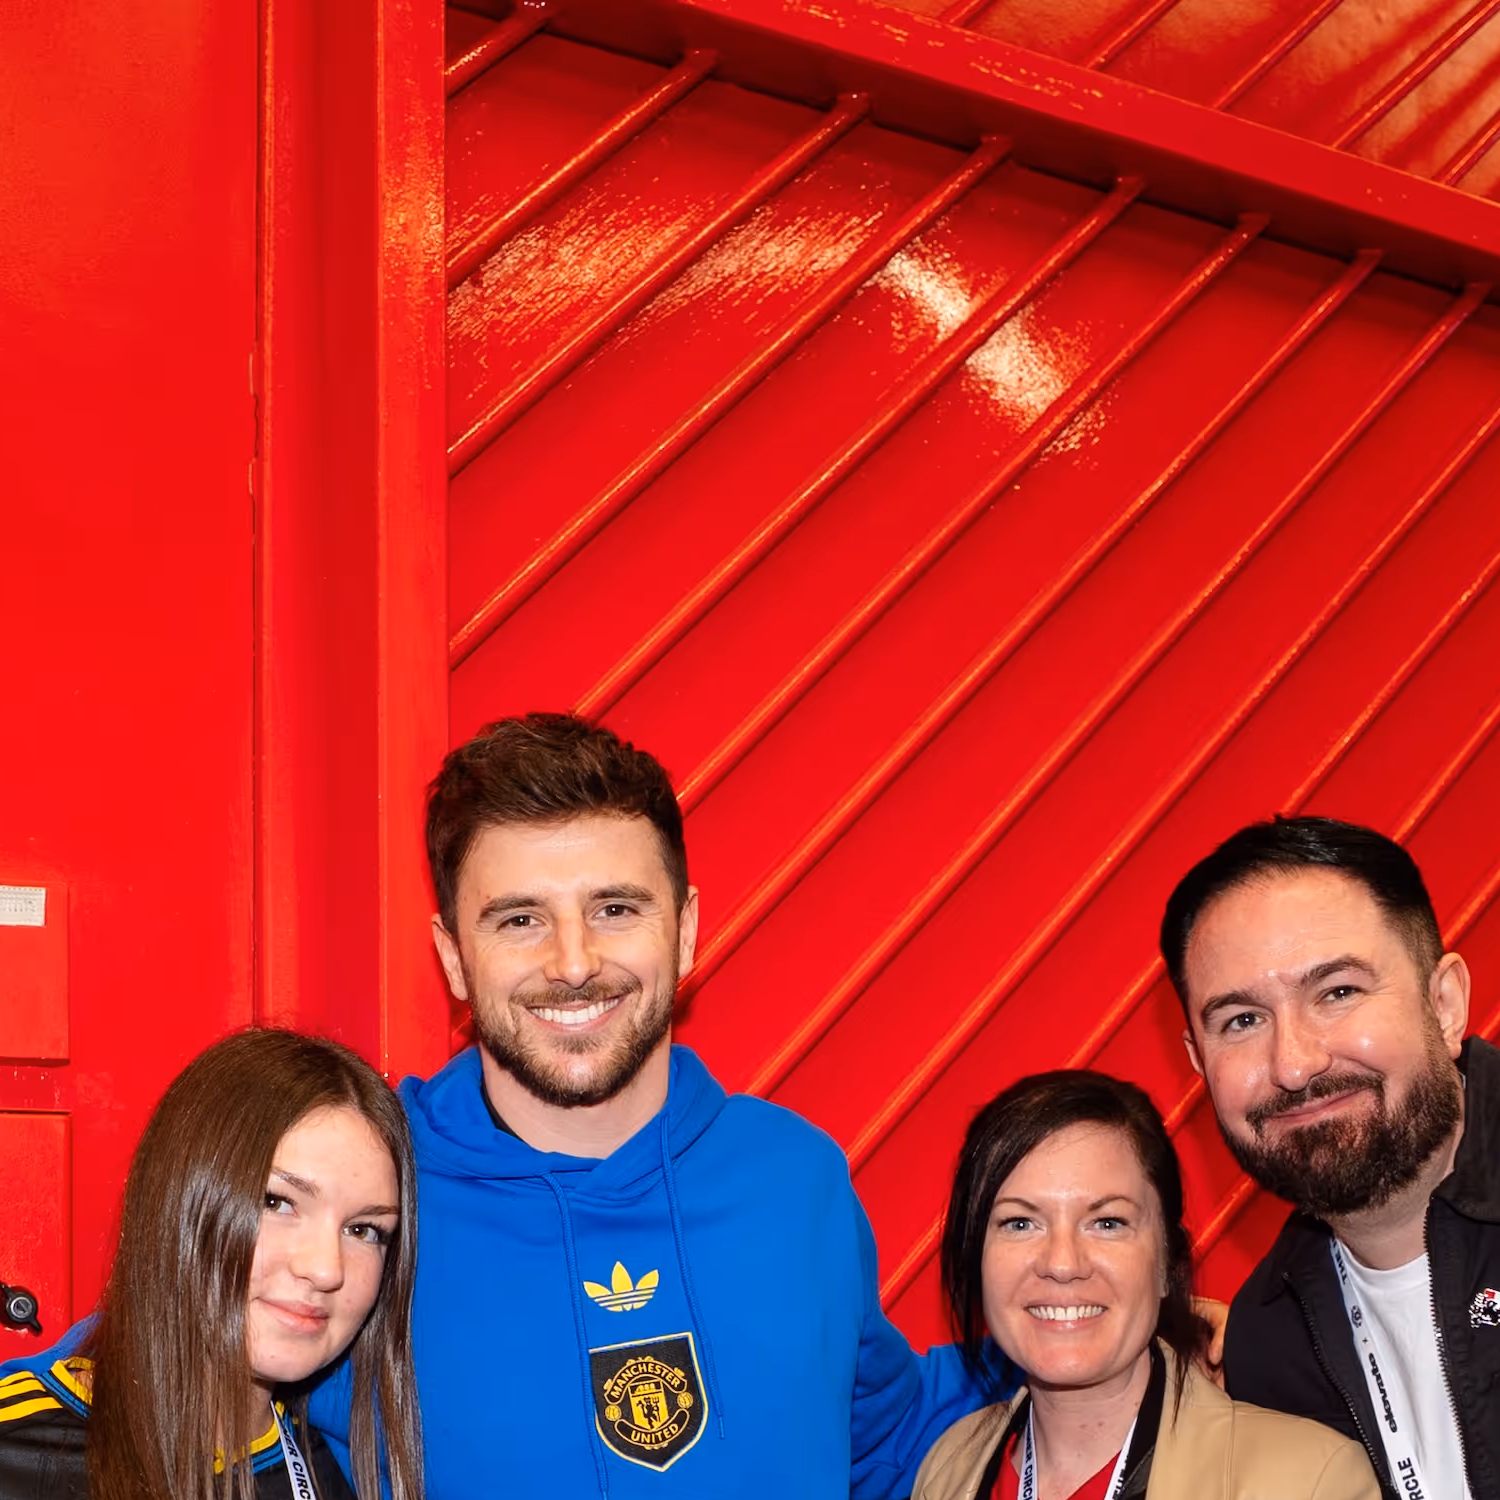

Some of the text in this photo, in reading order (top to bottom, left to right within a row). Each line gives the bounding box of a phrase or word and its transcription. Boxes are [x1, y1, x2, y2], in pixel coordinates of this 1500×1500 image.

[610, 1363, 680, 1398] MANCHESTER
[1368, 1352, 1398, 1434] elevate
[630, 1423, 679, 1443] UNITED
